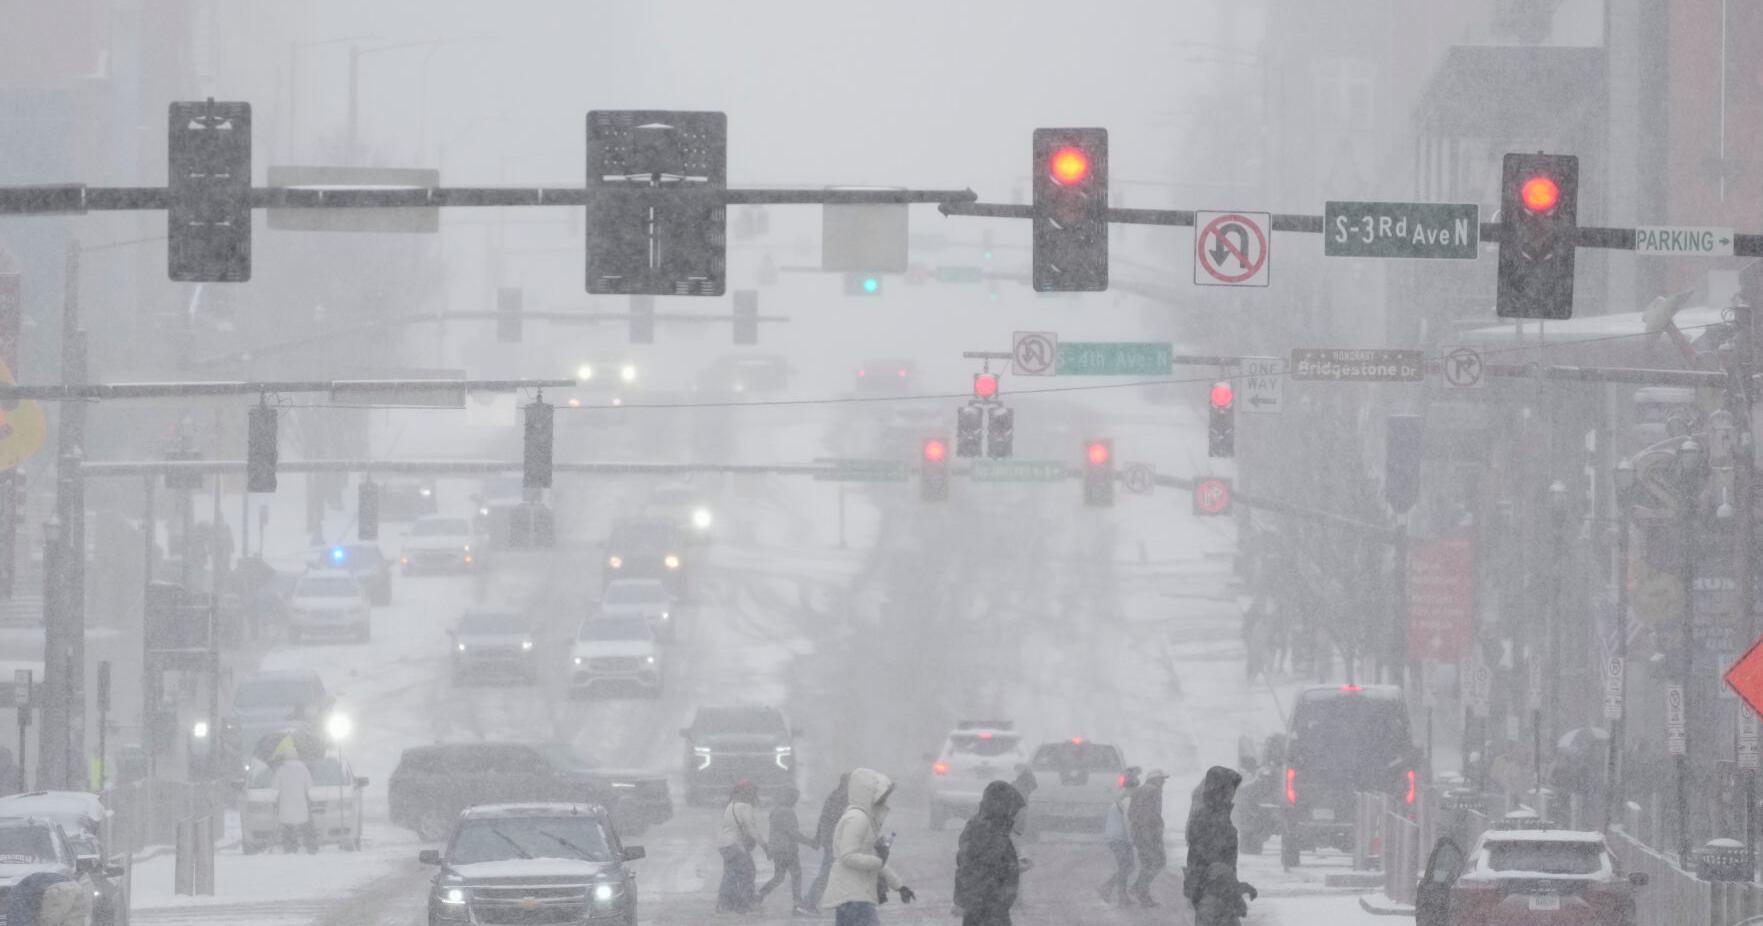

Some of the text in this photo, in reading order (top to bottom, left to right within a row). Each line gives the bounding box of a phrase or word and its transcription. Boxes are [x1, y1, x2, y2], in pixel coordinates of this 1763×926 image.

[1335, 215, 1469, 246] S-3Rd Ave N
[1636, 229, 1714, 252] PARKING
[1248, 361, 1278, 376] ONE
[1297, 359, 1417, 379] Bridgestone Dr
[1247, 377, 1278, 391] WAY
